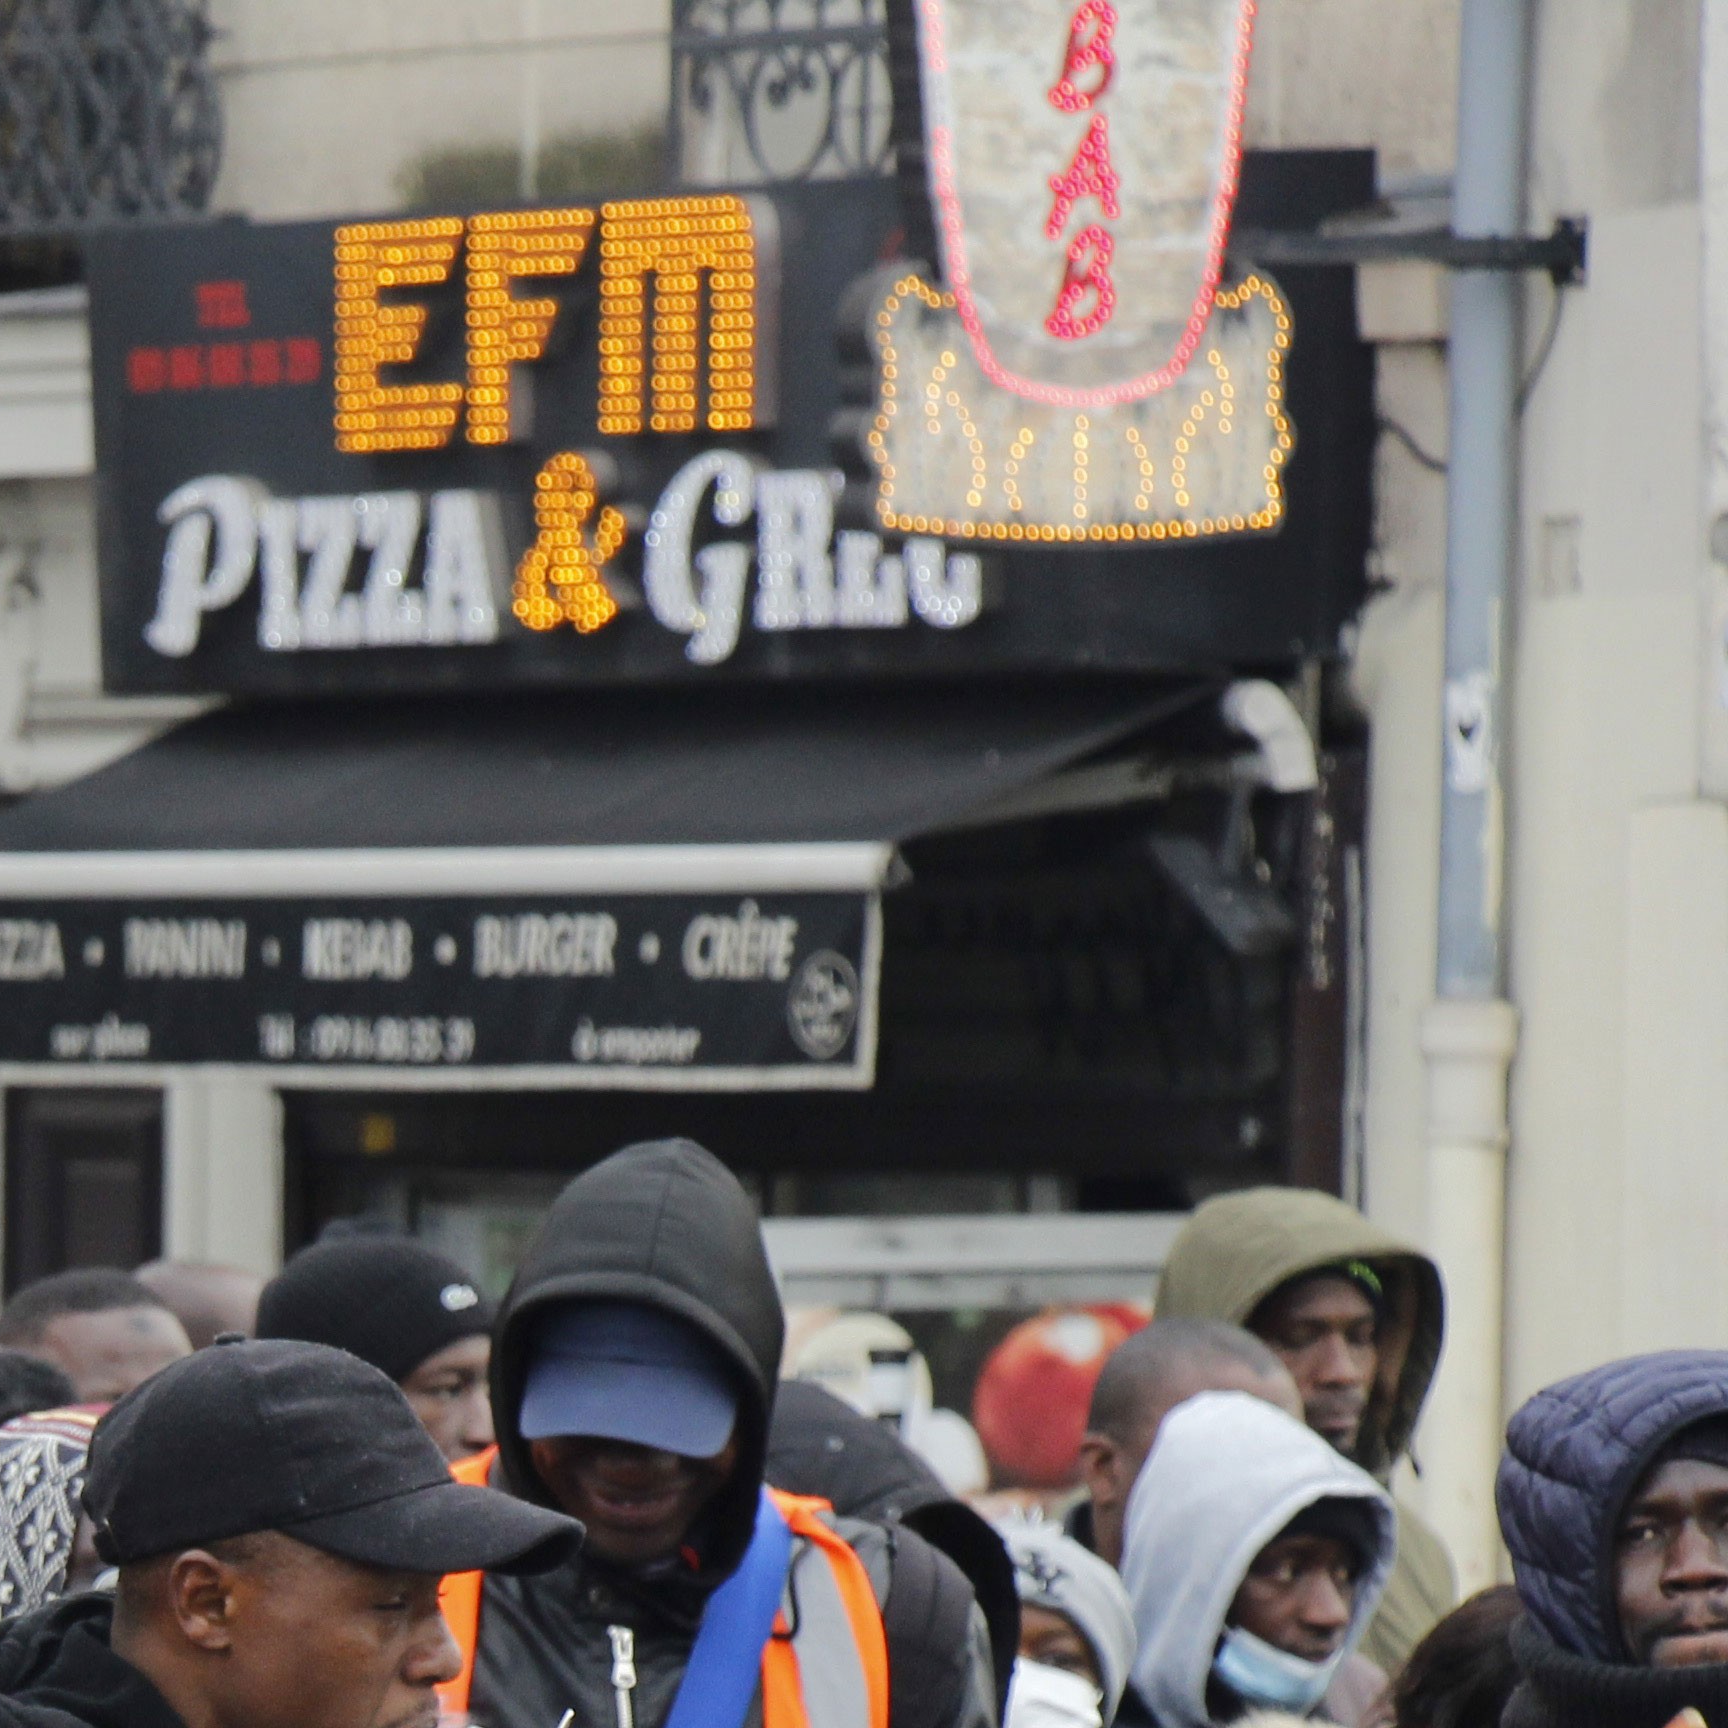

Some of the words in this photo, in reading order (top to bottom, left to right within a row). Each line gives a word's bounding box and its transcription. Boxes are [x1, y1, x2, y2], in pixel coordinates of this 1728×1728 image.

[335, 195, 754, 452] EFM
[145, 473, 501, 657] PIZZA
[512, 451, 625, 633] &
[124, 920, 246, 978] PANINI
[303, 918, 412, 980] KEBAB
[473, 912, 617, 978] BURGER
